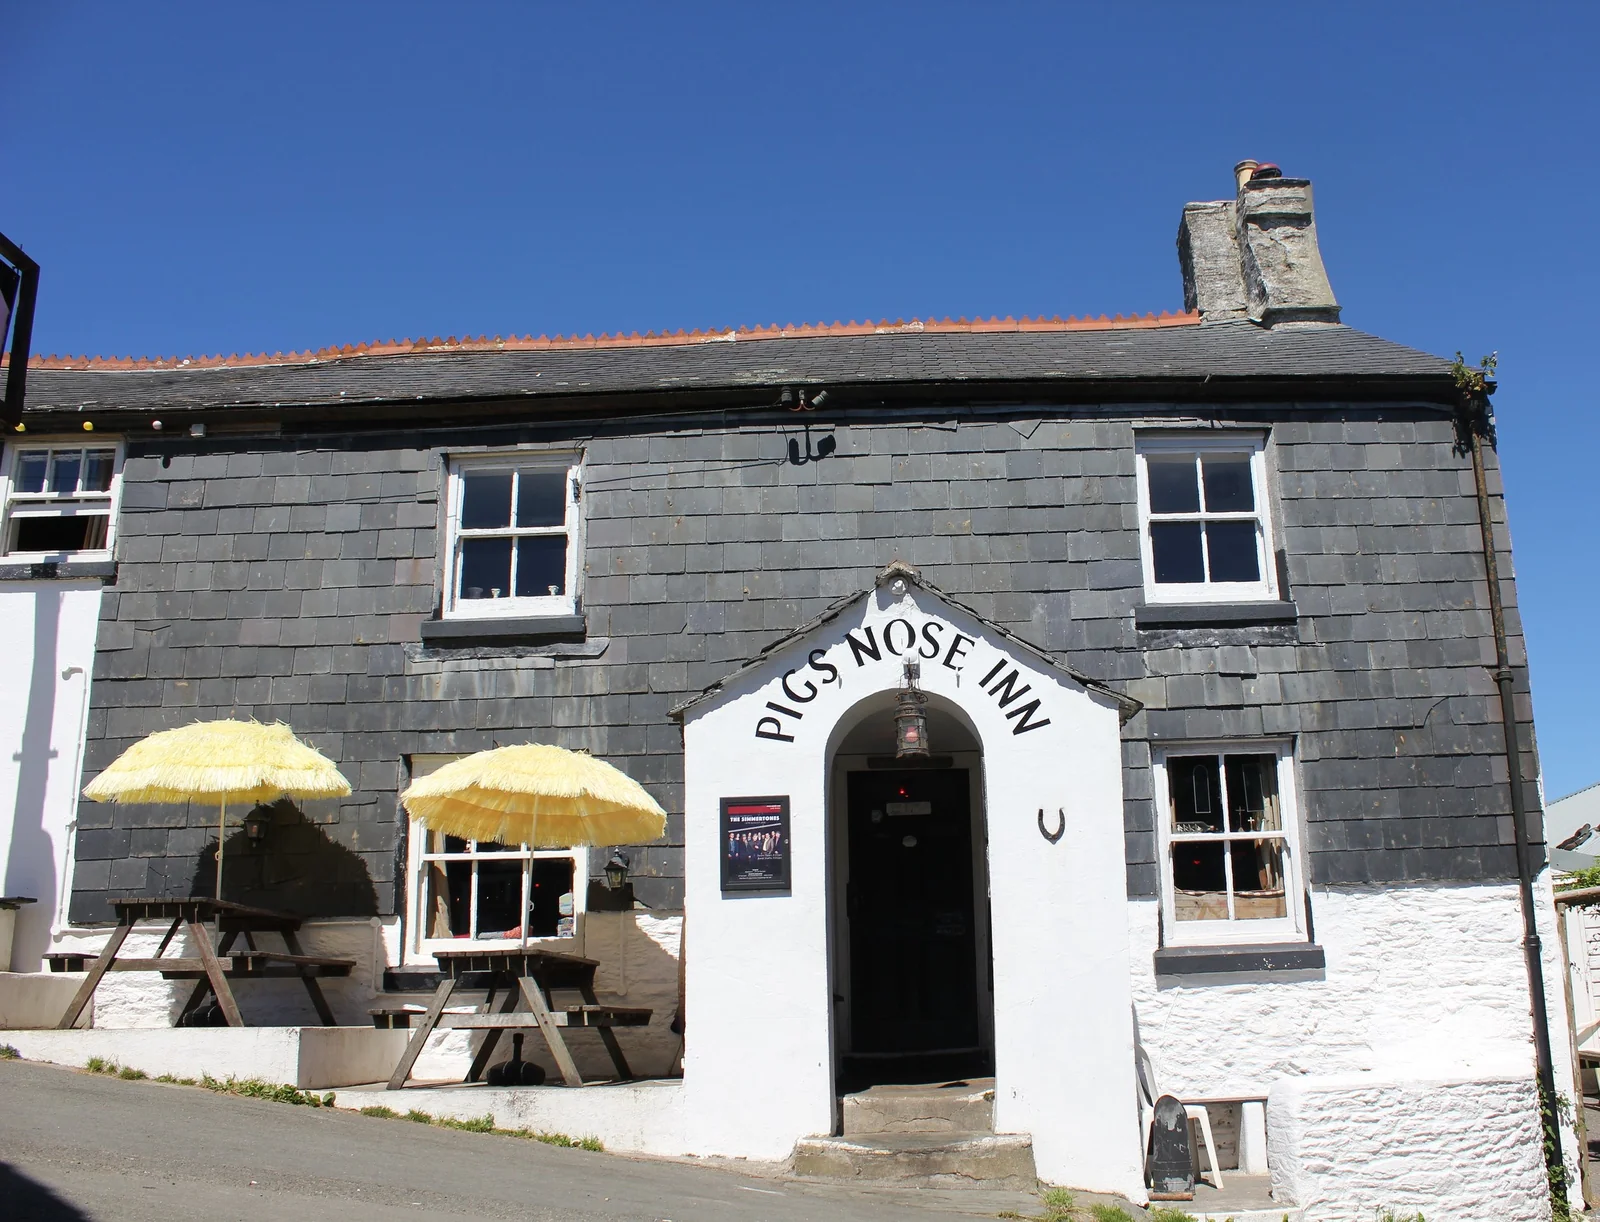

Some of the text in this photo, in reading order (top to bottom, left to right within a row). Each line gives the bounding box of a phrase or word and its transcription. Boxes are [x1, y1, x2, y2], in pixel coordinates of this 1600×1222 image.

[755, 618, 1051, 743] PIGS NOSE INN
